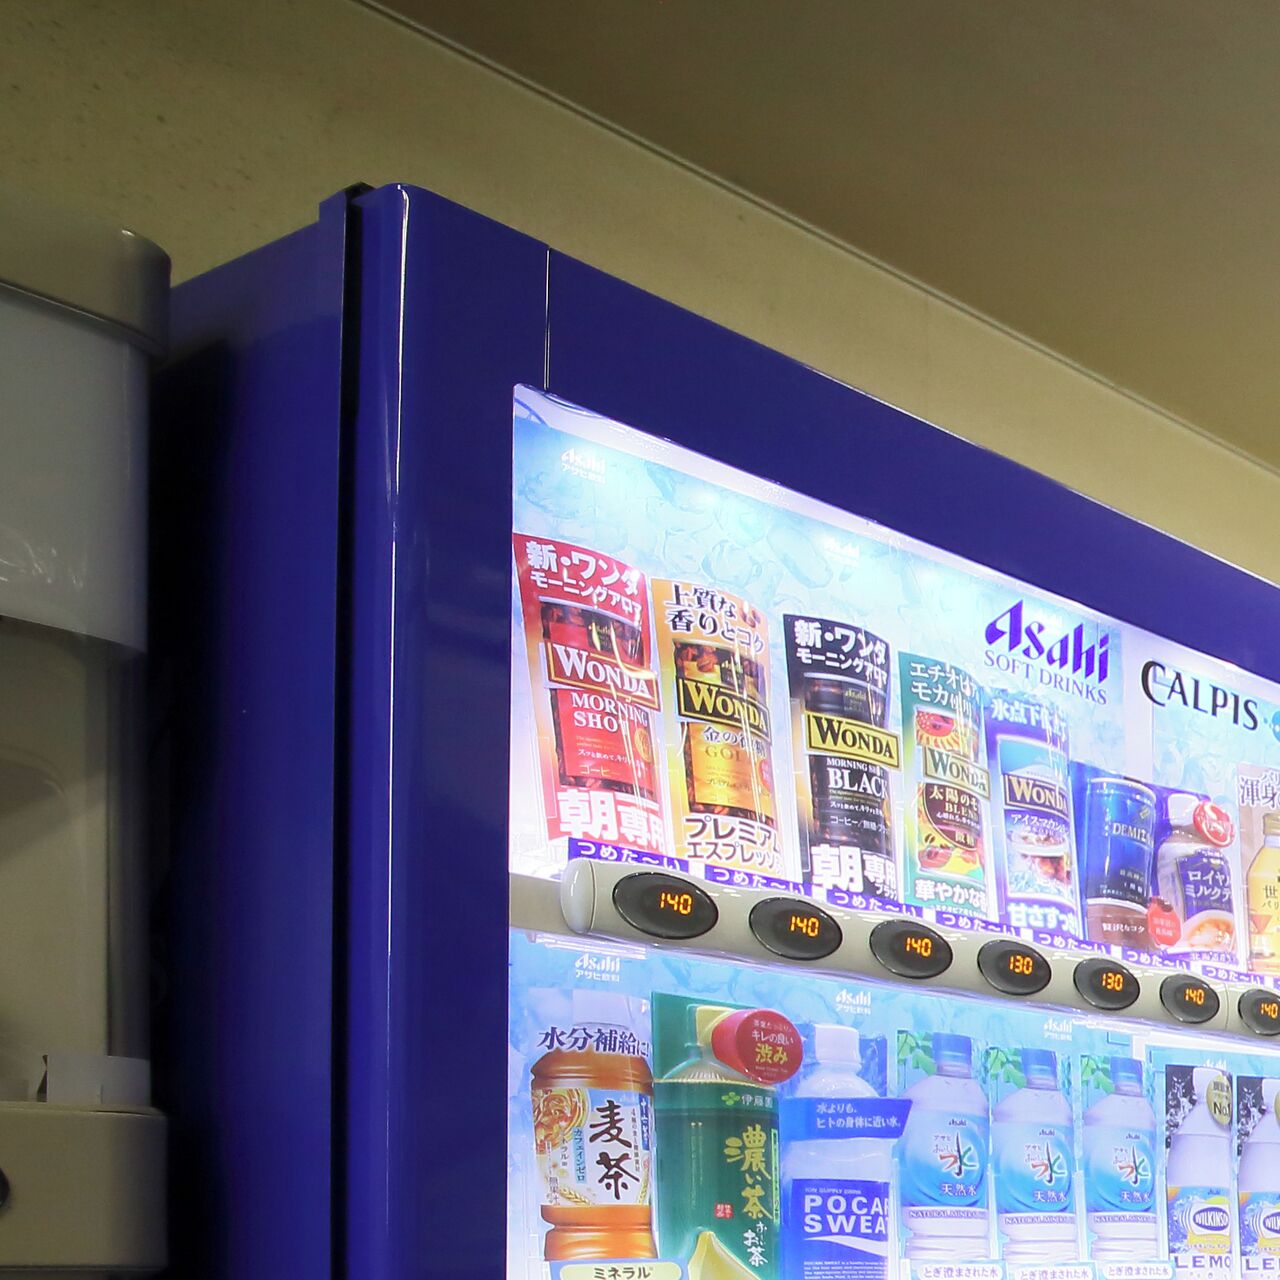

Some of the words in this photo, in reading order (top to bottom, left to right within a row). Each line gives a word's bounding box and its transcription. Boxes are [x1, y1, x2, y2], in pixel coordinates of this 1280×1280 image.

[985, 599, 1110, 685] Asahi
[551, 643, 652, 699] WONDA
[983, 650, 1034, 681] SOFT
[1038, 666, 1108, 706] DRINKS
[685, 680, 768, 730] WONDA
[1140, 660, 1259, 731] CALPIS
[812, 716, 895, 760] WONDA
[659, 893, 692, 915] 140
[788, 915, 818, 937] 140
[904, 937, 932, 957] 140
[1007, 955, 1032, 975] 130
[1100, 971, 1124, 991] 130
[1183, 987, 1205, 1005] 140
[1258, 1002, 1279, 1019] 140
[538, 1026, 650, 1058] 水分補給に!
[754, 1042, 789, 1066] 渋み
[588, 1099, 640, 1201] 麦茶
